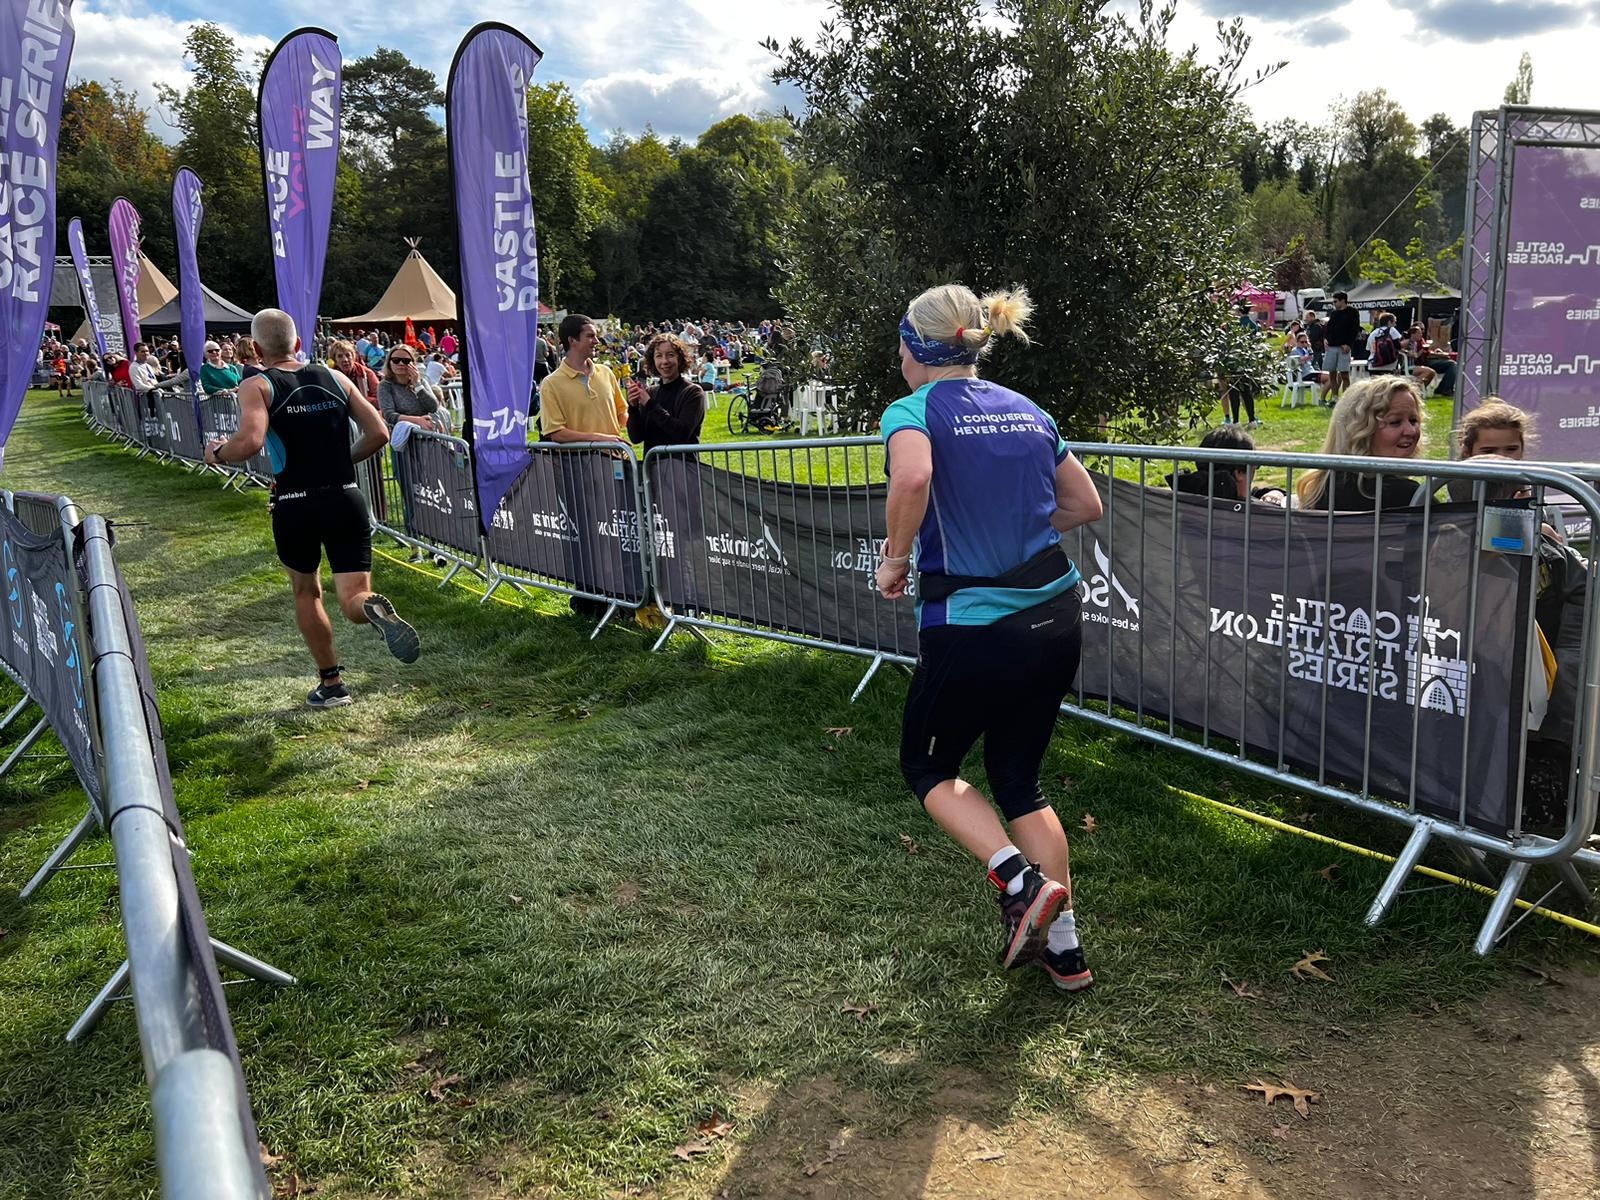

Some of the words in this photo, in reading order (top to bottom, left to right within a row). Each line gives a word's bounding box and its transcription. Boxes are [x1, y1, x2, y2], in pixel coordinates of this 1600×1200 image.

[15, 0, 64, 147] SERIE
[306, 54, 336, 149] WAY
[12, 151, 47, 302] RACE
[494, 151, 521, 311] CASTLE
[287, 400, 338, 414] RUNBREEZE
[953, 425, 998, 436] HEVER
[1000, 424, 1045, 434] CASTLE
[954, 415, 960, 424] I
[962, 413, 1035, 423] CONQUERED
